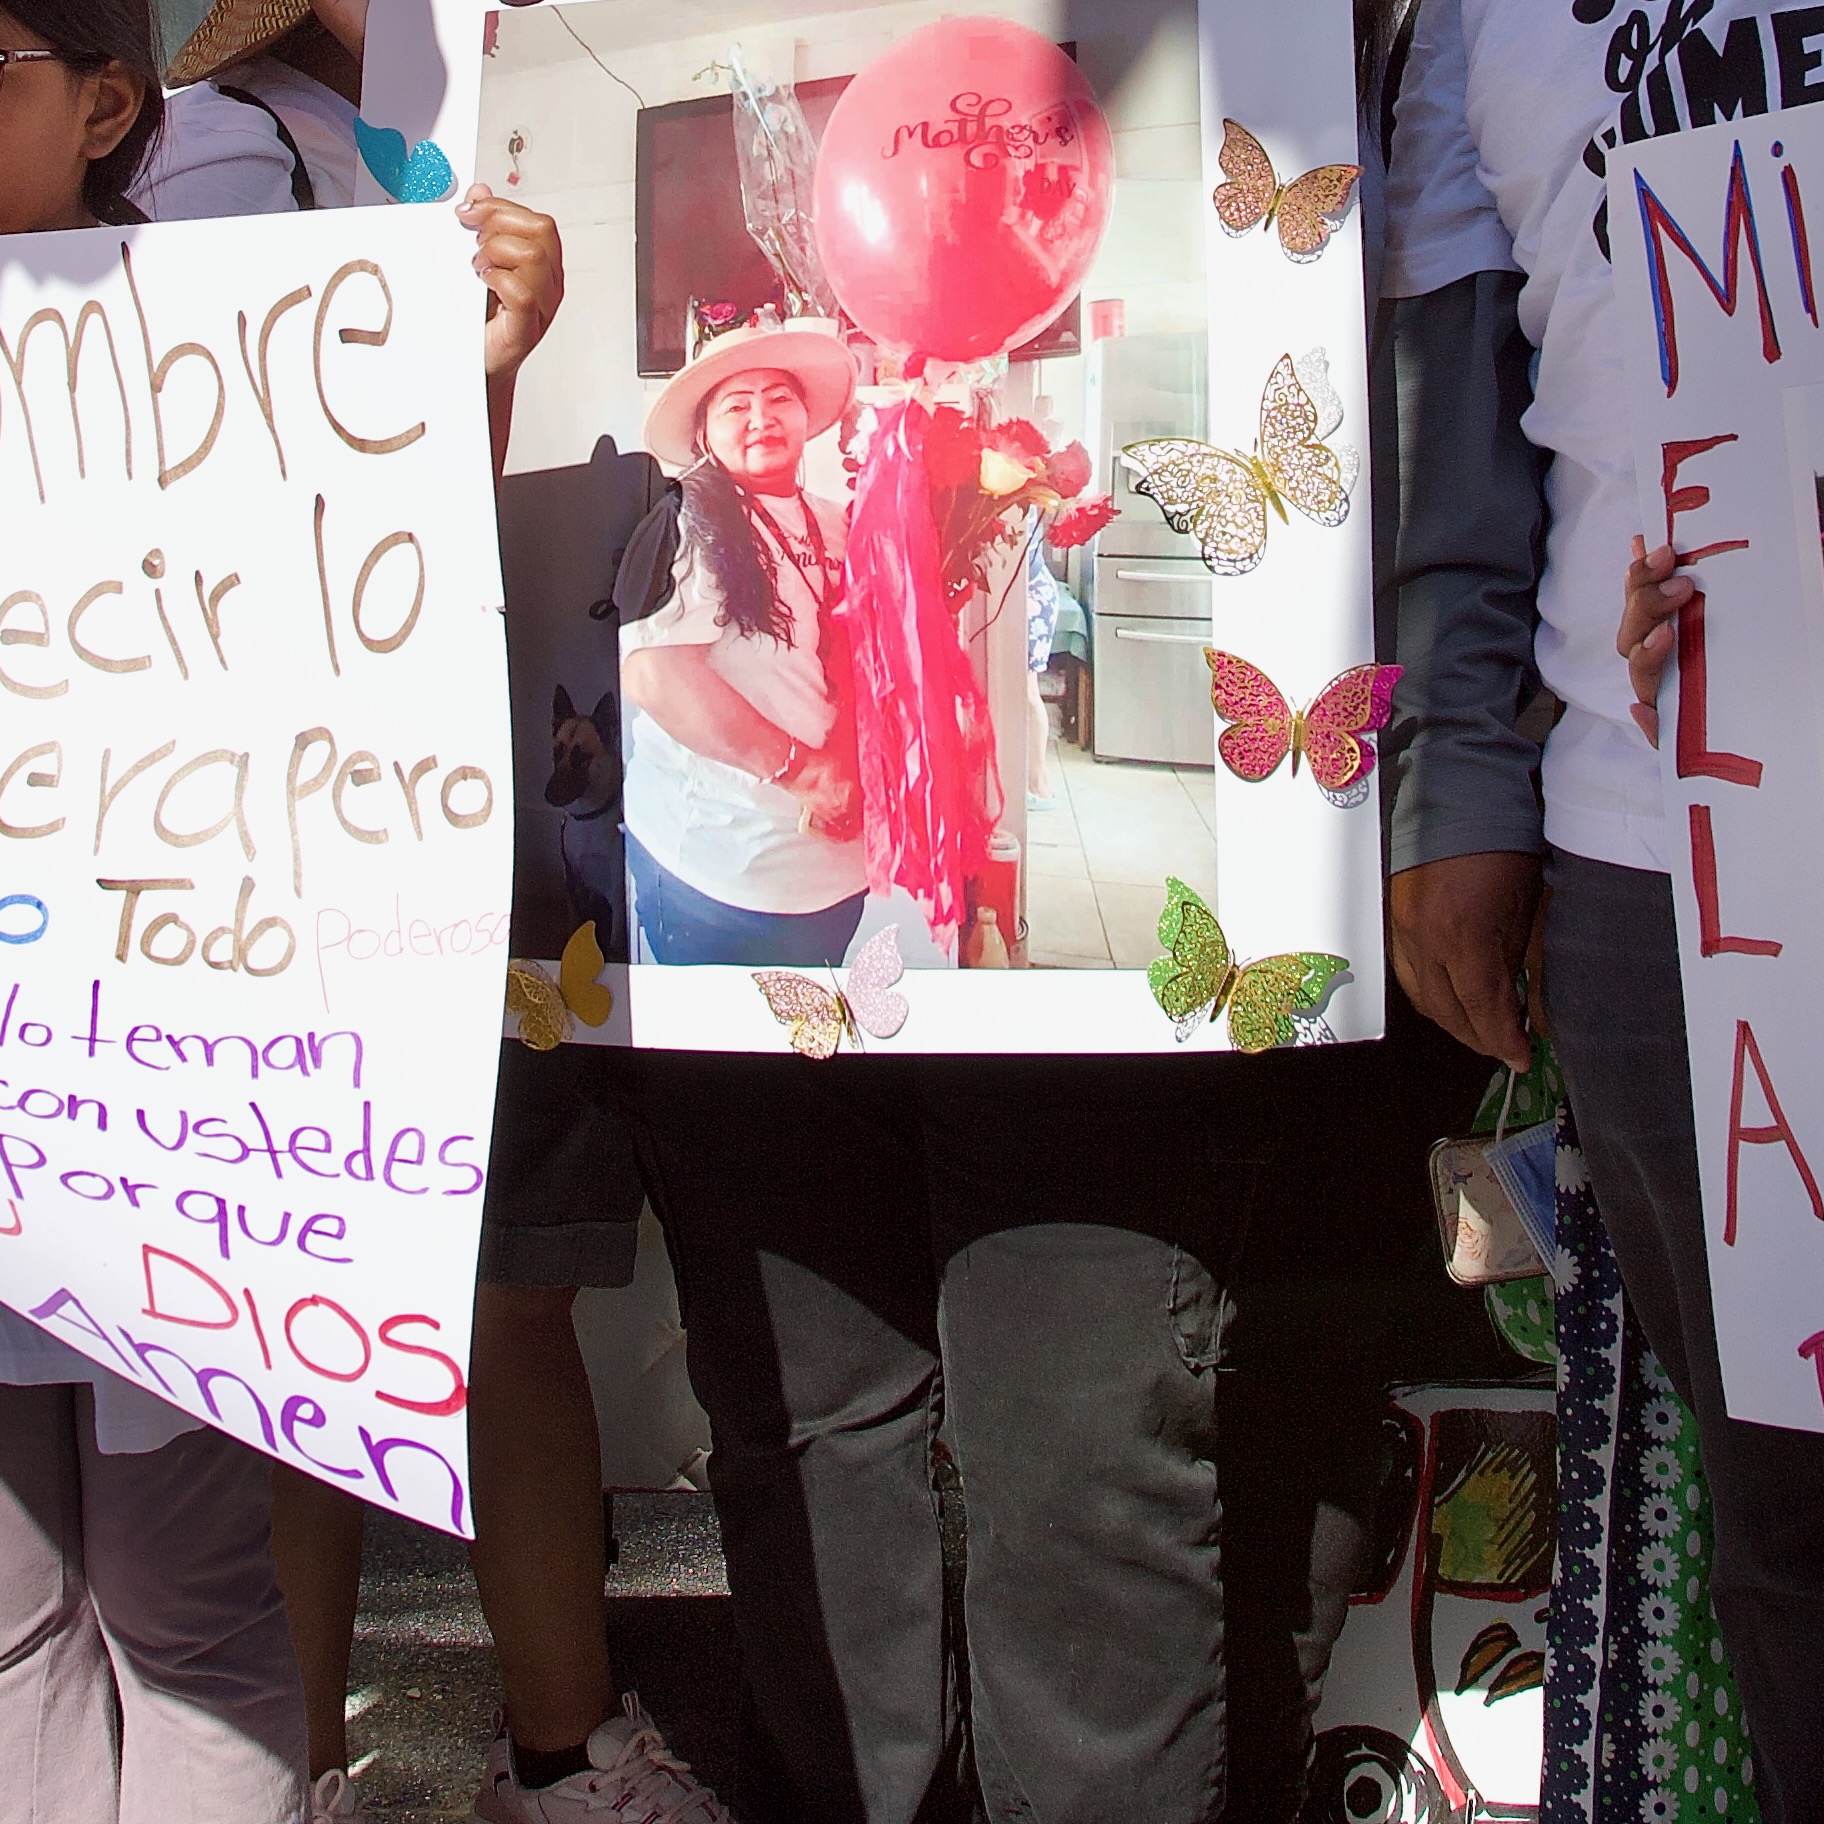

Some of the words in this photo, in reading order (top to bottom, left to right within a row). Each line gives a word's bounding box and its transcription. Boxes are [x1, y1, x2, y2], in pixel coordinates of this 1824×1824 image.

[881, 91, 1074, 169] Mother's
[1040, 177, 1076, 198] DAY
[1635, 136, 1822, 394] Mi
[315, 492, 427, 677] lo
[288, 725, 495, 898] pero
[96, 876, 296, 976] Todo
[71, 980, 362, 1088] teman
[136, 1101, 483, 1195] ustedes
[141, 1243, 468, 1417] DIOS
[28, 1287, 465, 1534] Amen
